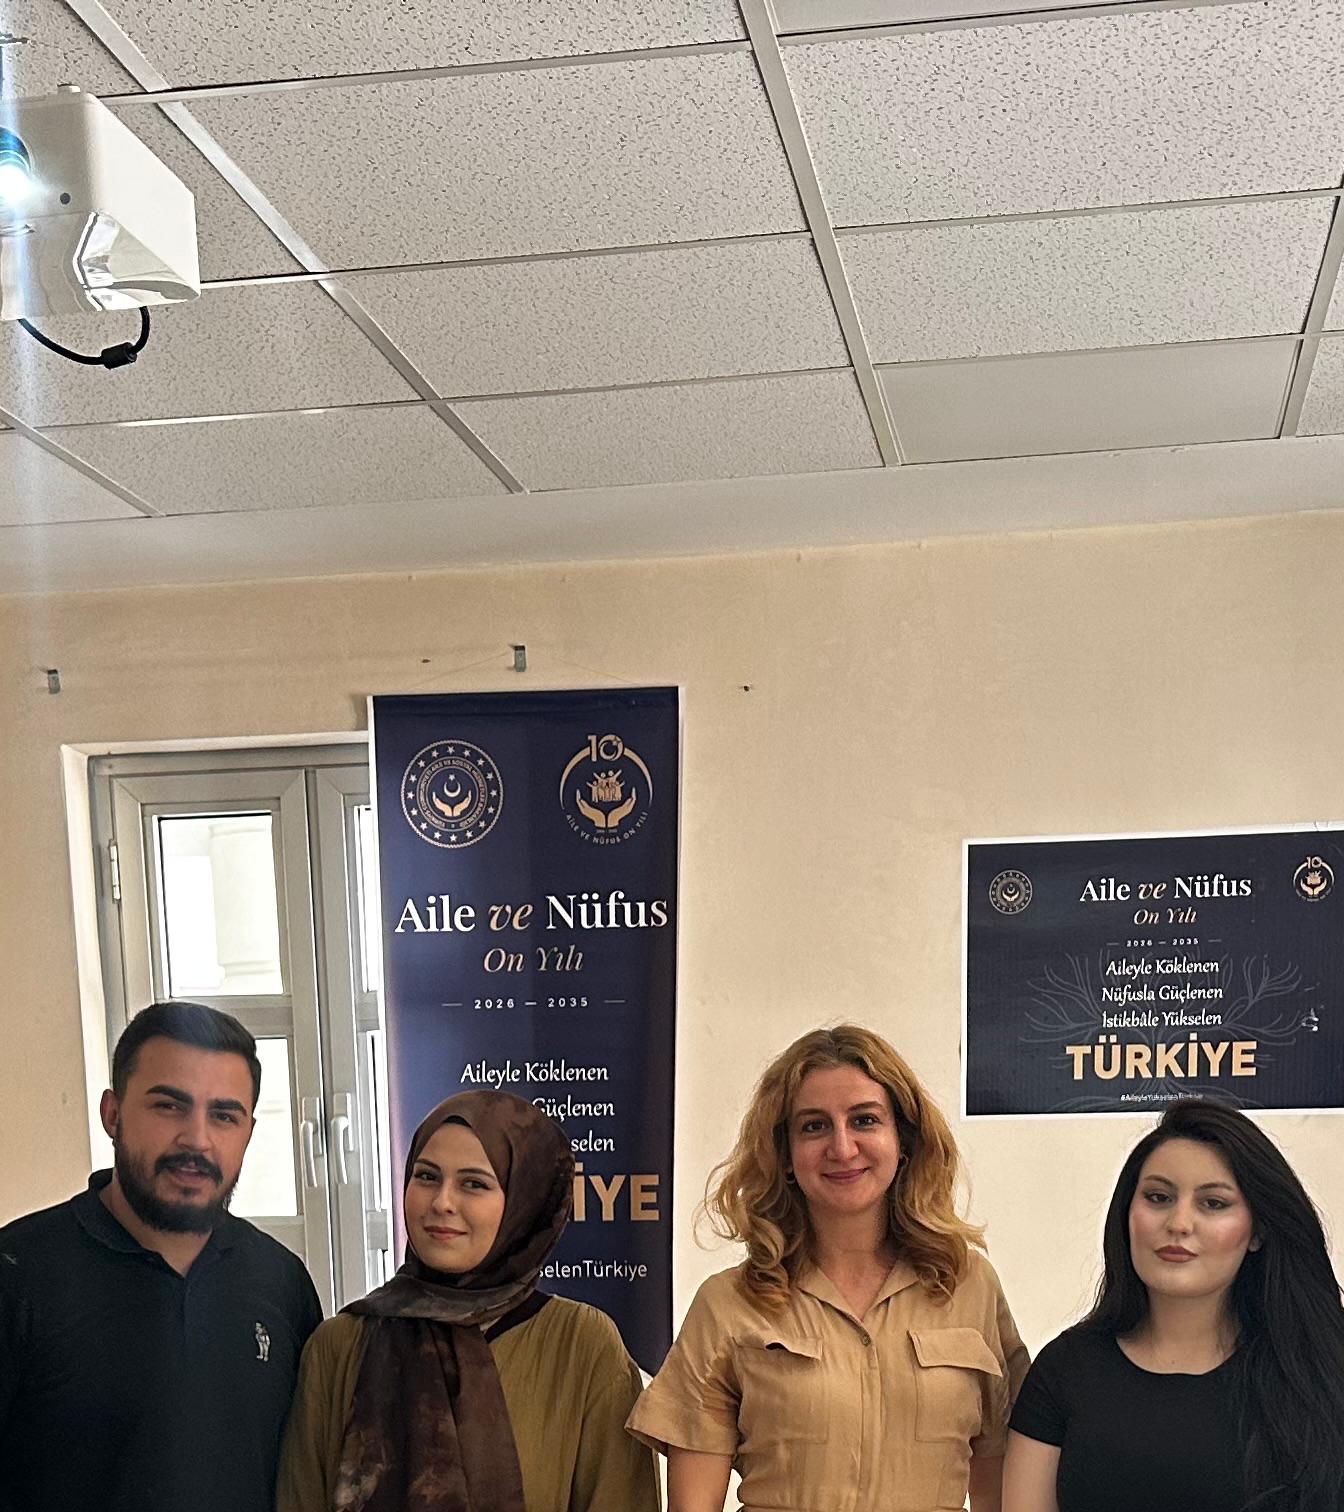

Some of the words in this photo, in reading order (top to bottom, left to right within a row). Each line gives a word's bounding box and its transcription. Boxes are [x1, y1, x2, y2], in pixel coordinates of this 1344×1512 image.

[1080, 878, 1130, 901] Aile
[1139, 883, 1166, 899] ve
[1174, 874, 1251, 898] Nüfus
[395, 895, 475, 932] Aile
[489, 905, 532, 930] ve
[546, 891, 667, 929] Nüfus
[1134, 910, 1159, 924] On
[1168, 907, 1196, 923] Yılı
[484, 949, 523, 972] On
[537, 945, 582, 970] Yılı
[1106, 958, 1152, 979] Aileyle
[1156, 956, 1219, 974] Köklenen
[548, 997, 587, 1007] 2035
[1102, 984, 1155, 1006] Nüfusla
[1159, 983, 1222, 1003] Güçlenen
[1162, 1008, 1222, 1026] Yükselen
[1066, 1033, 1256, 1080] TÜRKİYE
[461, 1061, 520, 1089] Aileyle
[525, 1060, 608, 1081] Köklenen
[572, 1130, 614, 1151] selen
